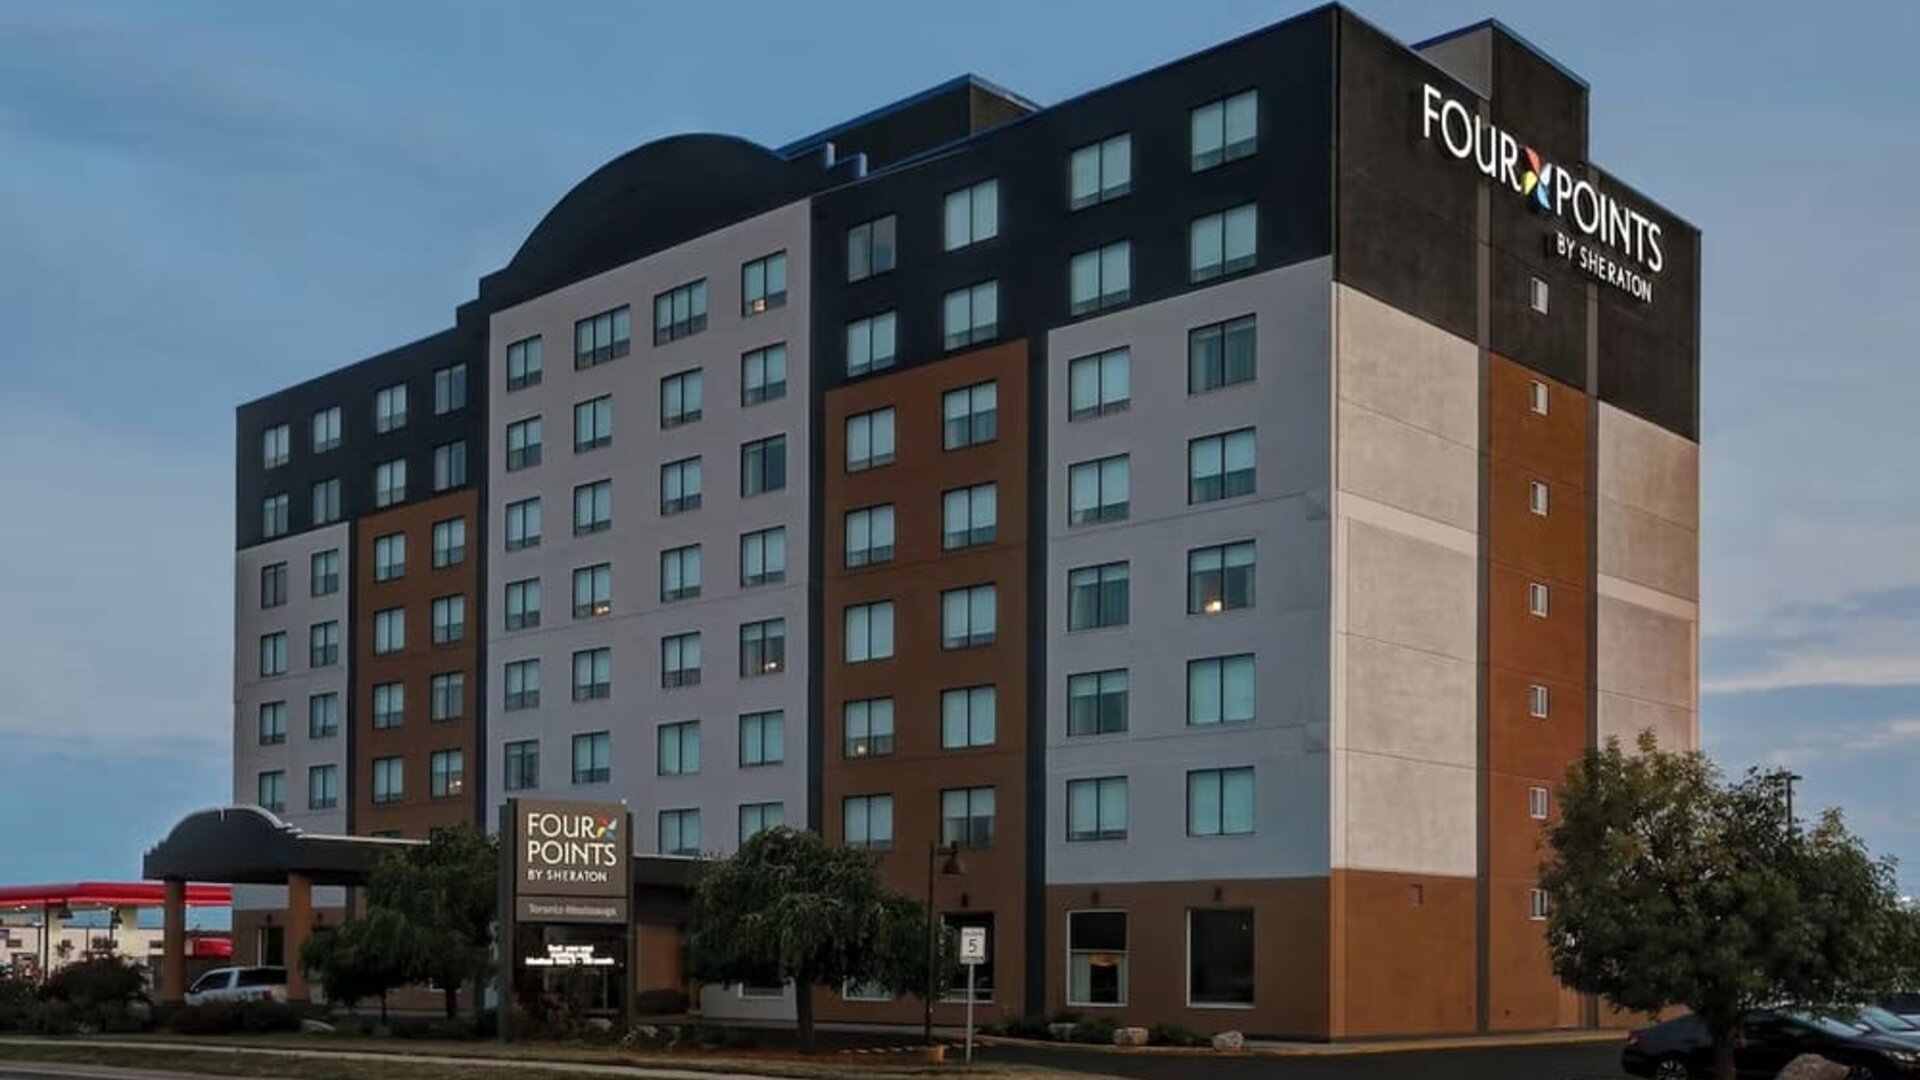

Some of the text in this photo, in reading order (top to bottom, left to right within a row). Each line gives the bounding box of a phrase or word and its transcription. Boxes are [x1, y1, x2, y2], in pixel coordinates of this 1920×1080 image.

[1423, 83, 1664, 273] FOUR POINTS
[1556, 231, 1652, 304] BY SHERATON
[527, 813, 596, 839] FOUR
[527, 840, 617, 866] POINTS
[527, 870, 608, 882] BY SHERATON
[968, 938, 977, 953] 5
